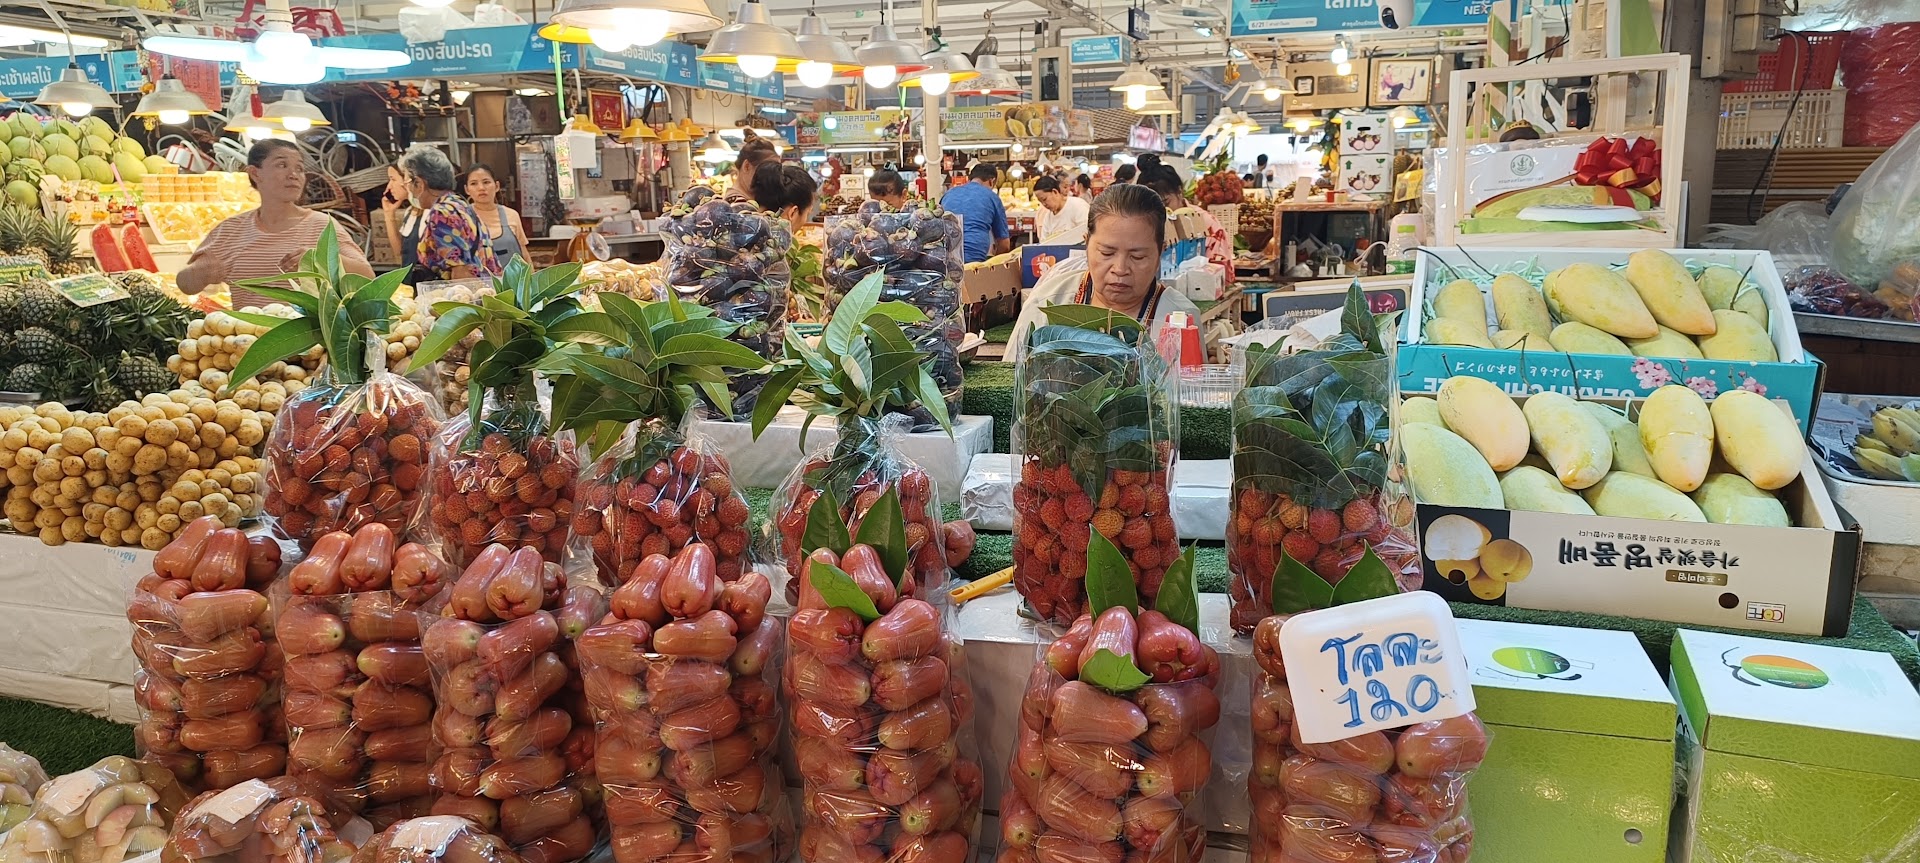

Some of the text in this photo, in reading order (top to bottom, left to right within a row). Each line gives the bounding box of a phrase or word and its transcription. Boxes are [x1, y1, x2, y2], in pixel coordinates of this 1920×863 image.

[548, 53, 572, 64] NXT
[0, 65, 52, 86] ะเช้าผลไม้
[1558, 537, 1740, 571] 가을햇살 명품배
